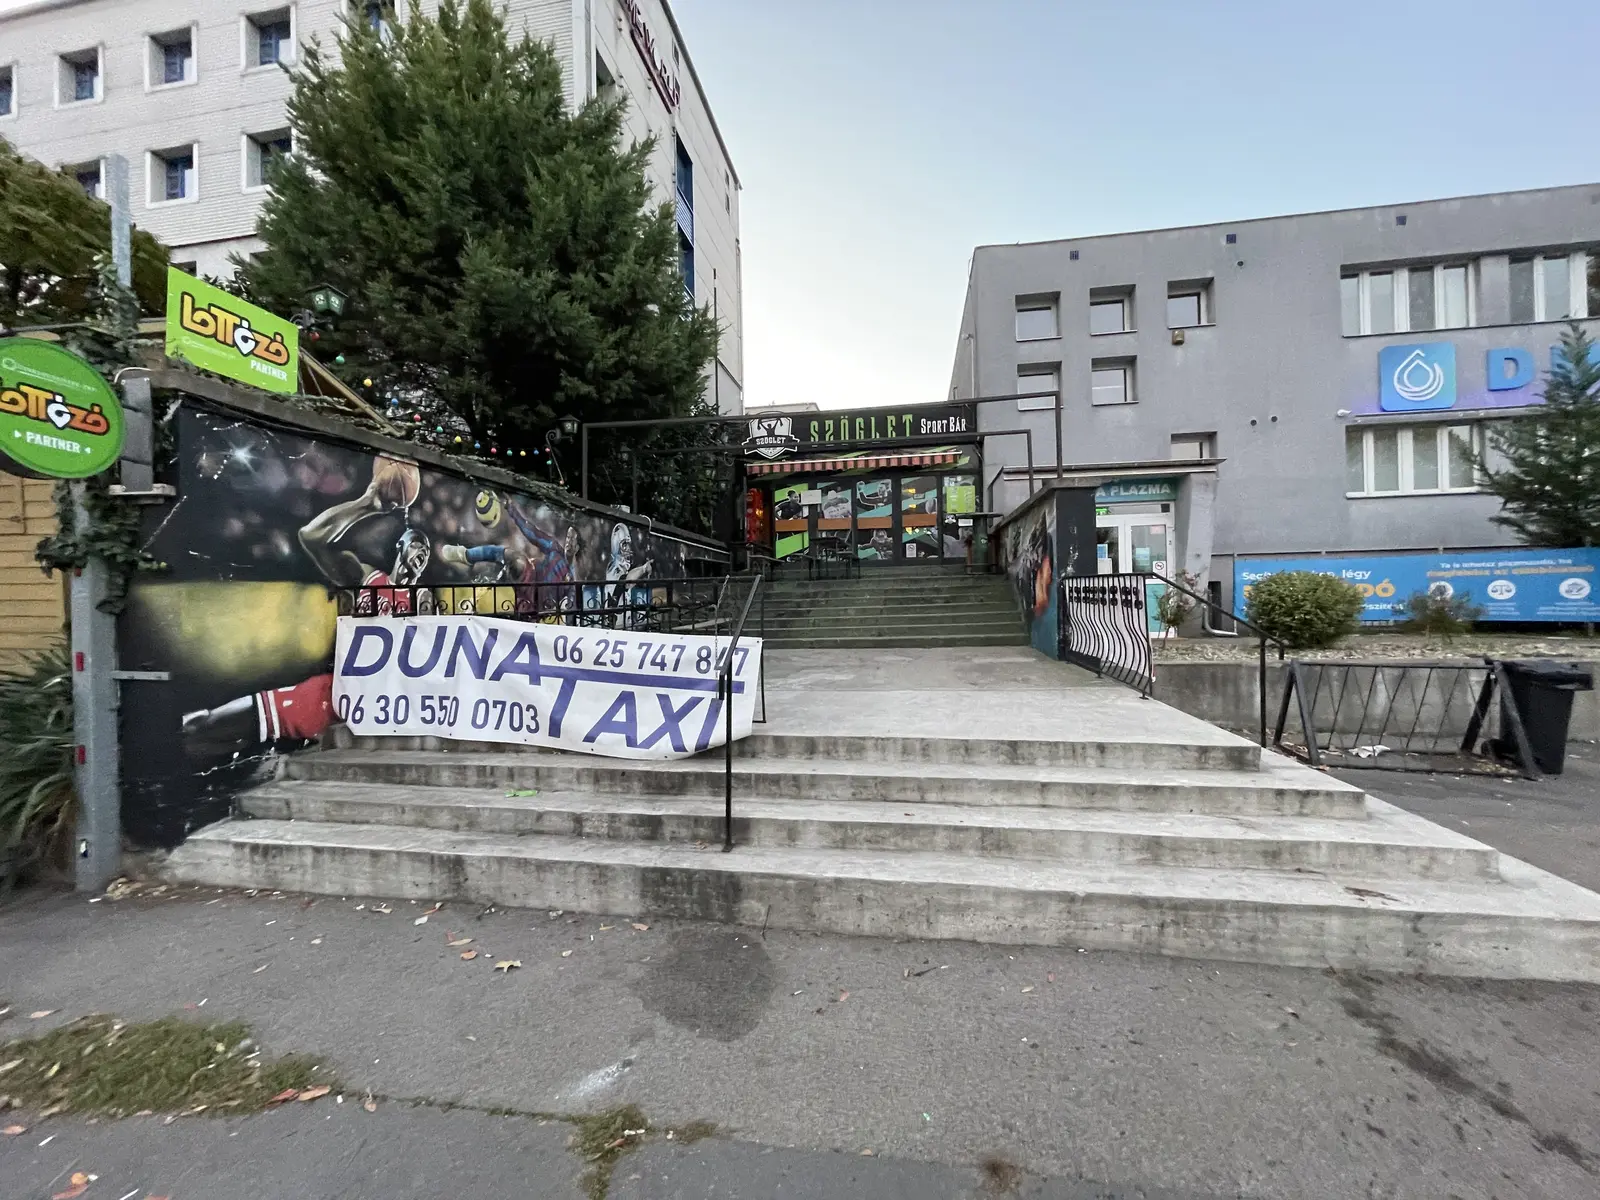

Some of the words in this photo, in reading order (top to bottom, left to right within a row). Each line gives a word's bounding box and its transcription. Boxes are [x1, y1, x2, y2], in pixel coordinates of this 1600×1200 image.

[250, 359, 288, 382] PARTNER
[26, 431, 81, 454] PARTNER
[810, 413, 913, 443] SZÖGLET
[920, 418, 948, 434] SPORT
[949, 416, 967, 432] BÁR
[1110, 483, 1171, 496] PLAZMA
[1341, 569, 1372, 580] légy
[340, 624, 541, 687] DUNA
[554, 634, 584, 664] 06
[593, 638, 629, 669] 25
[637, 641, 687, 673] 747
[695, 644, 750, 678] 847
[338, 693, 365, 726] 06
[374, 693, 410, 727] 30
[420, 694, 460, 728] 550
[471, 698, 540, 734] 0703
[541, 664, 746, 753] TAXI
